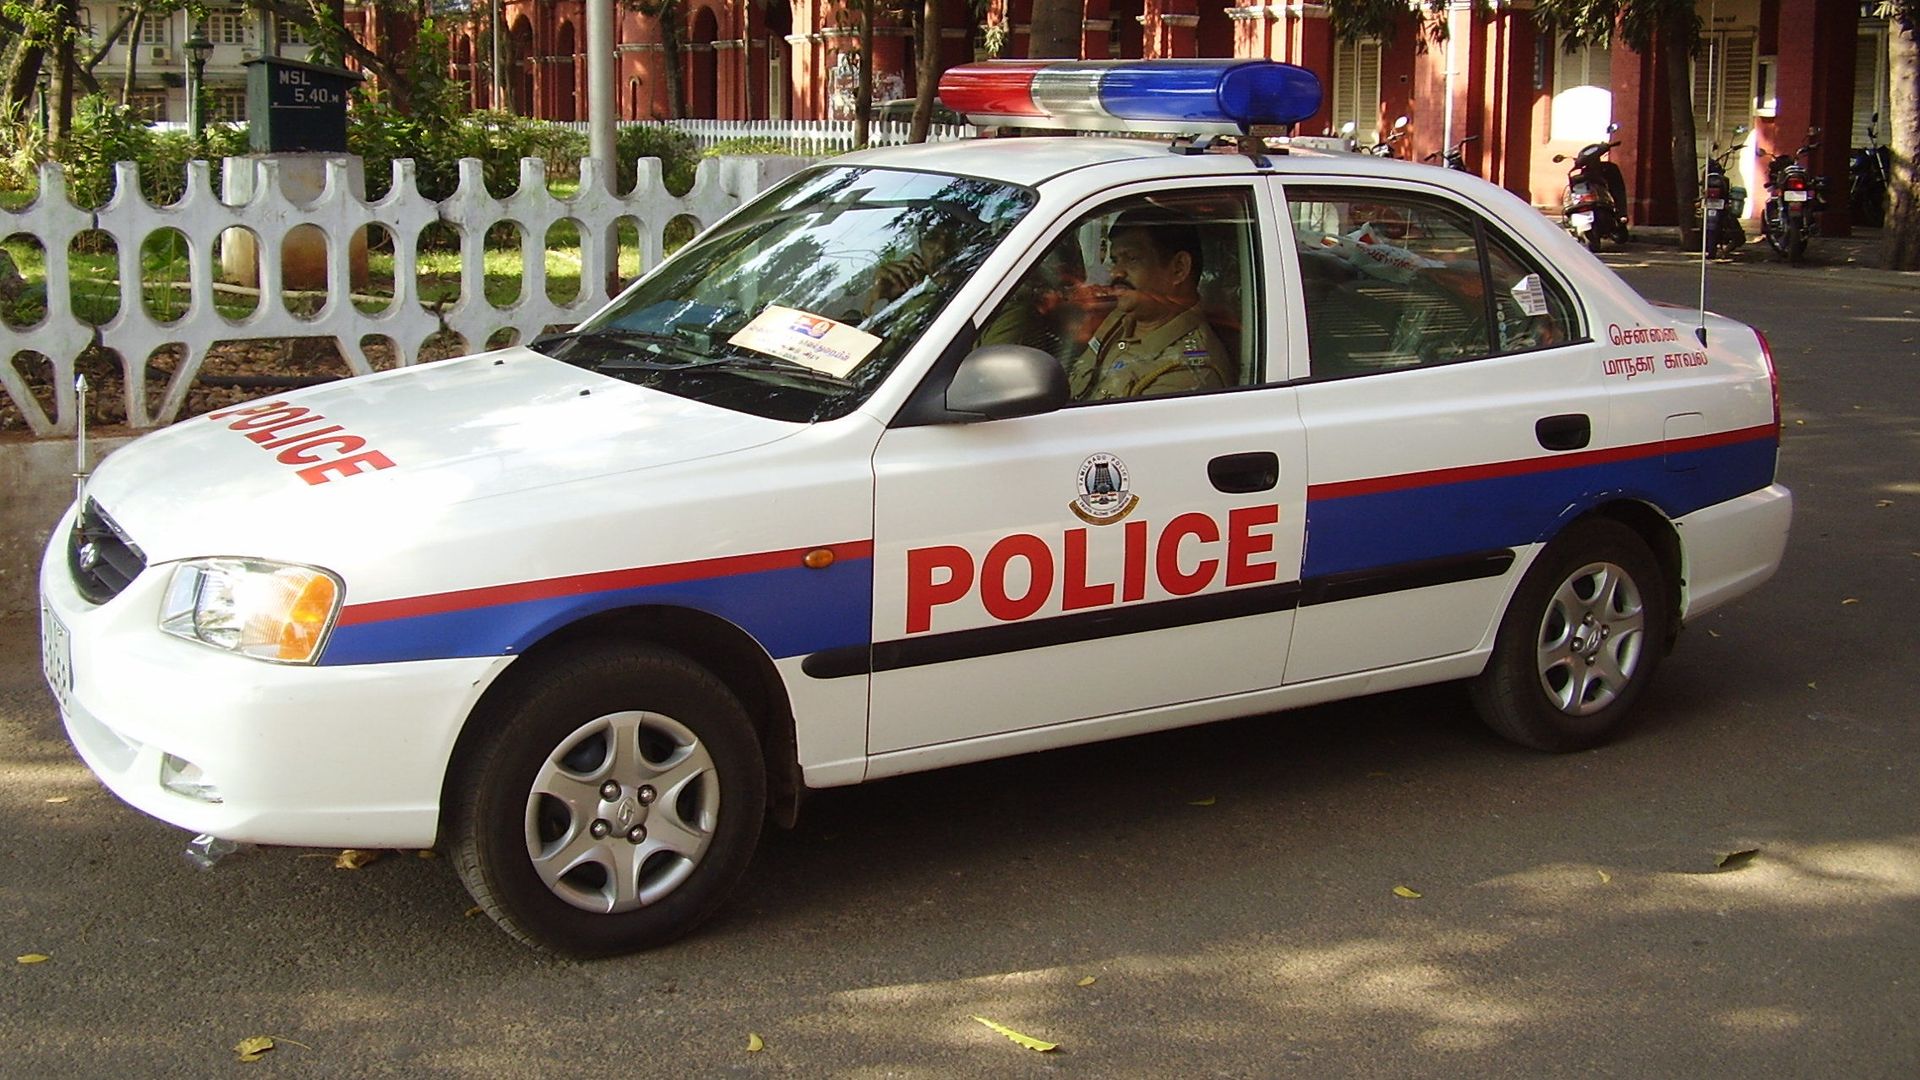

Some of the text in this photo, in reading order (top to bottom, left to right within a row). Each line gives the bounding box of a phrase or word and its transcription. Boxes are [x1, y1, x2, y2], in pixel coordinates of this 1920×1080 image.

[279, 70, 311, 85] MSL
[1608, 322, 1679, 346] சென்னை
[1602, 355, 1656, 380] மாநகர
[208, 401, 397, 486] POLICE
[1110, 457, 1128, 482] POLICE
[905, 503, 1280, 635] POLICE
